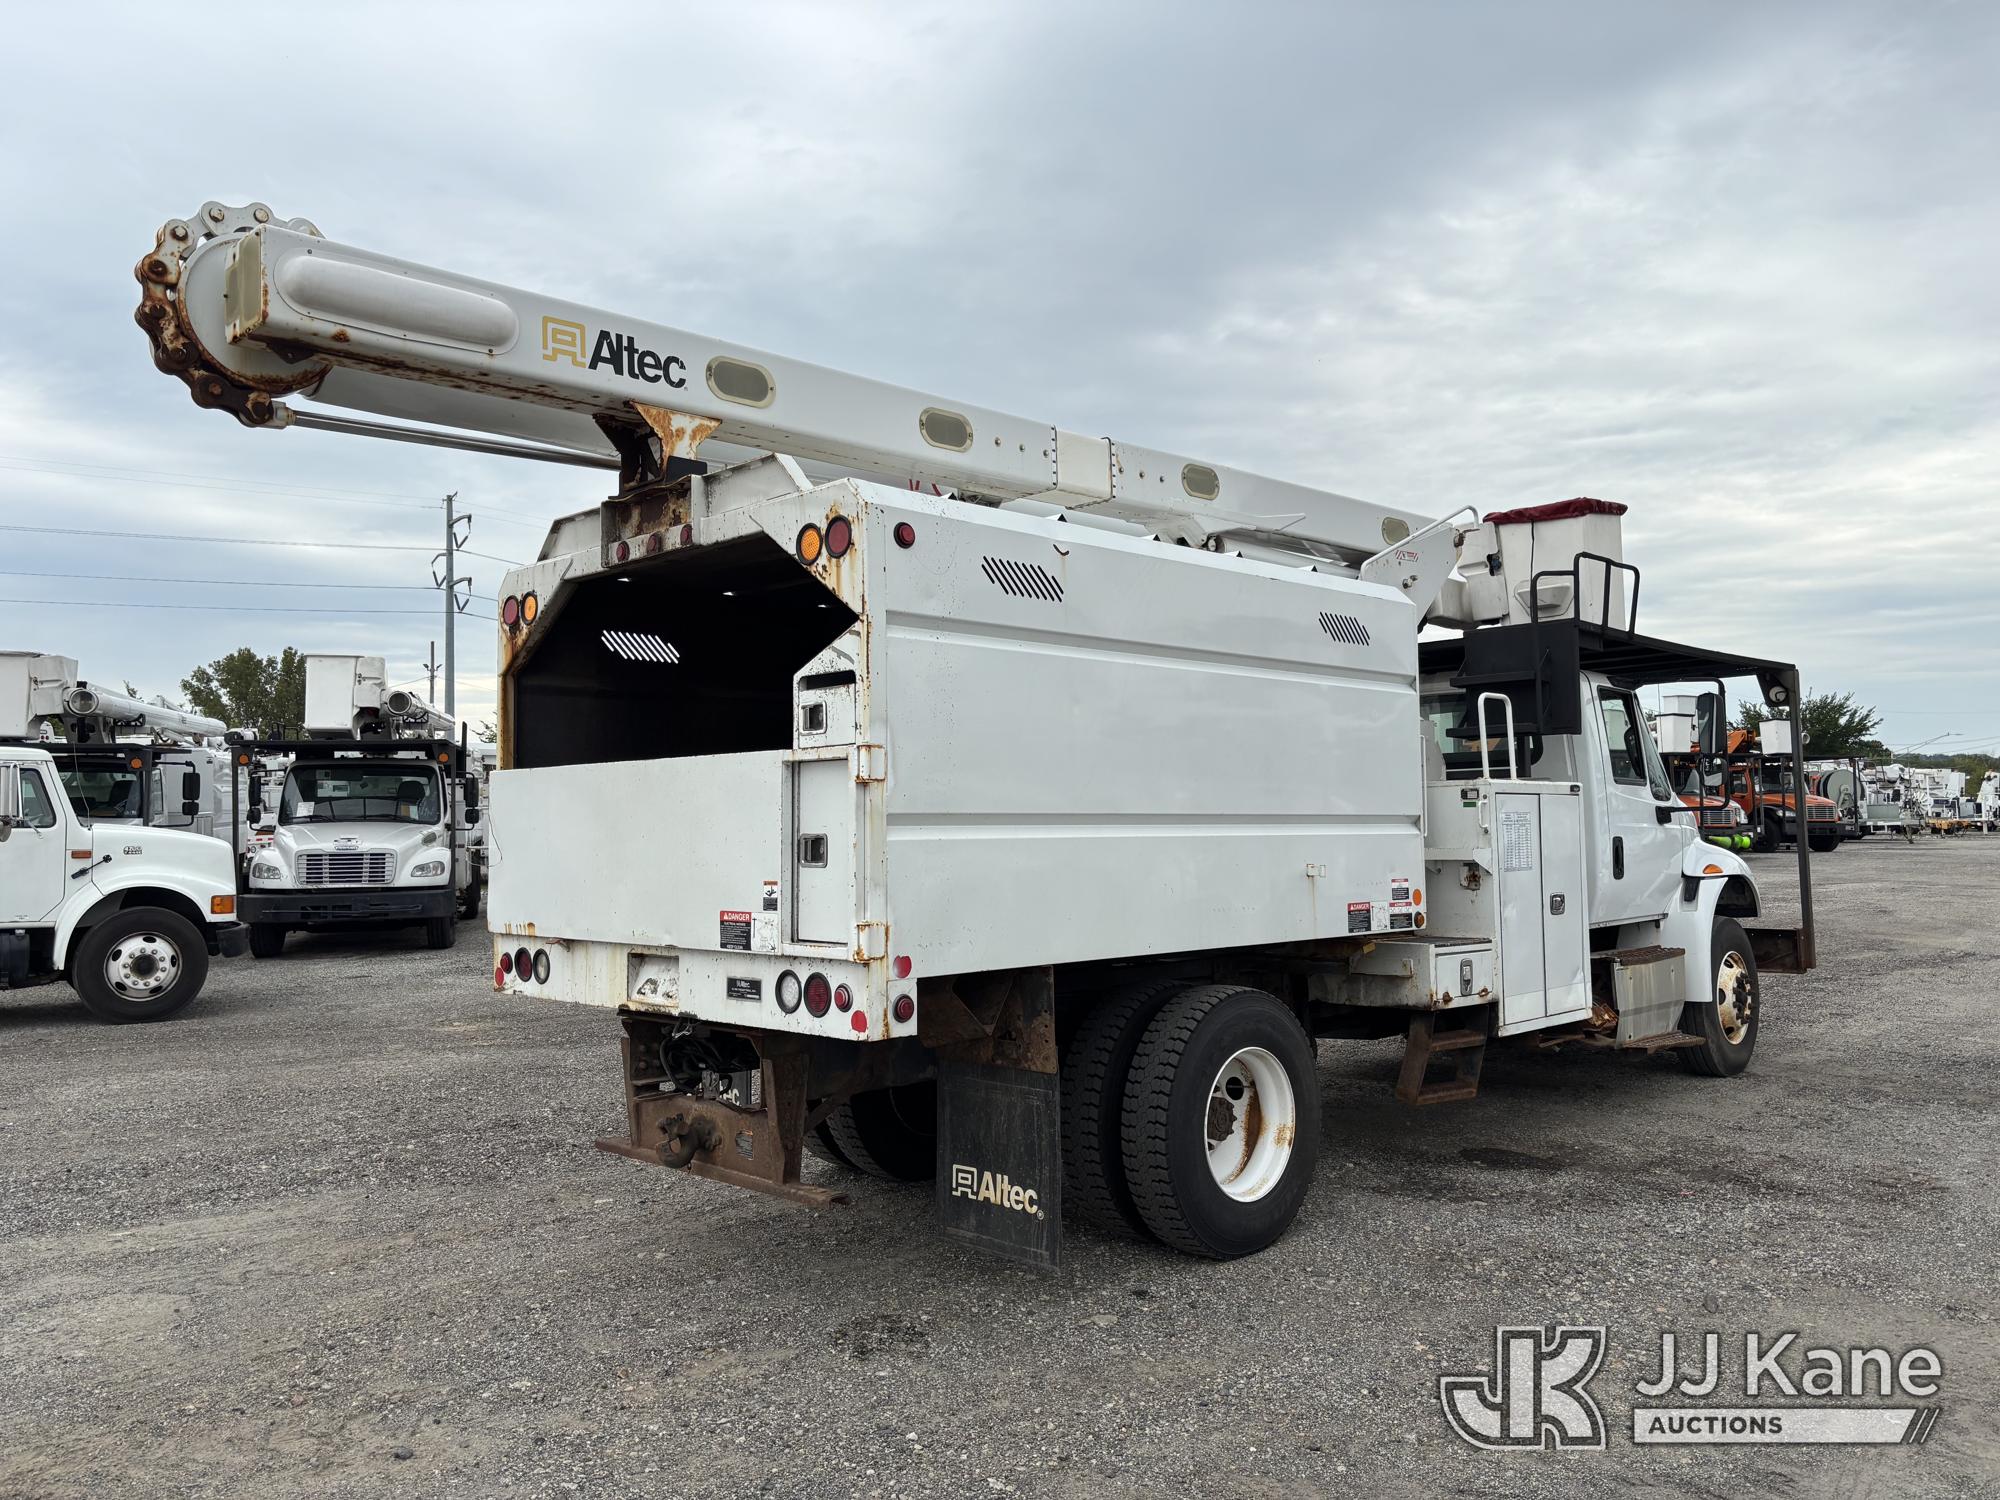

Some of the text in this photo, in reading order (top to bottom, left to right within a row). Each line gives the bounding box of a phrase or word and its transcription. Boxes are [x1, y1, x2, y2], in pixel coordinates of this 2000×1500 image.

[588, 329, 687, 389] Altec
[728, 912, 750, 921] DANGER
[977, 1170, 1039, 1214] Altec
